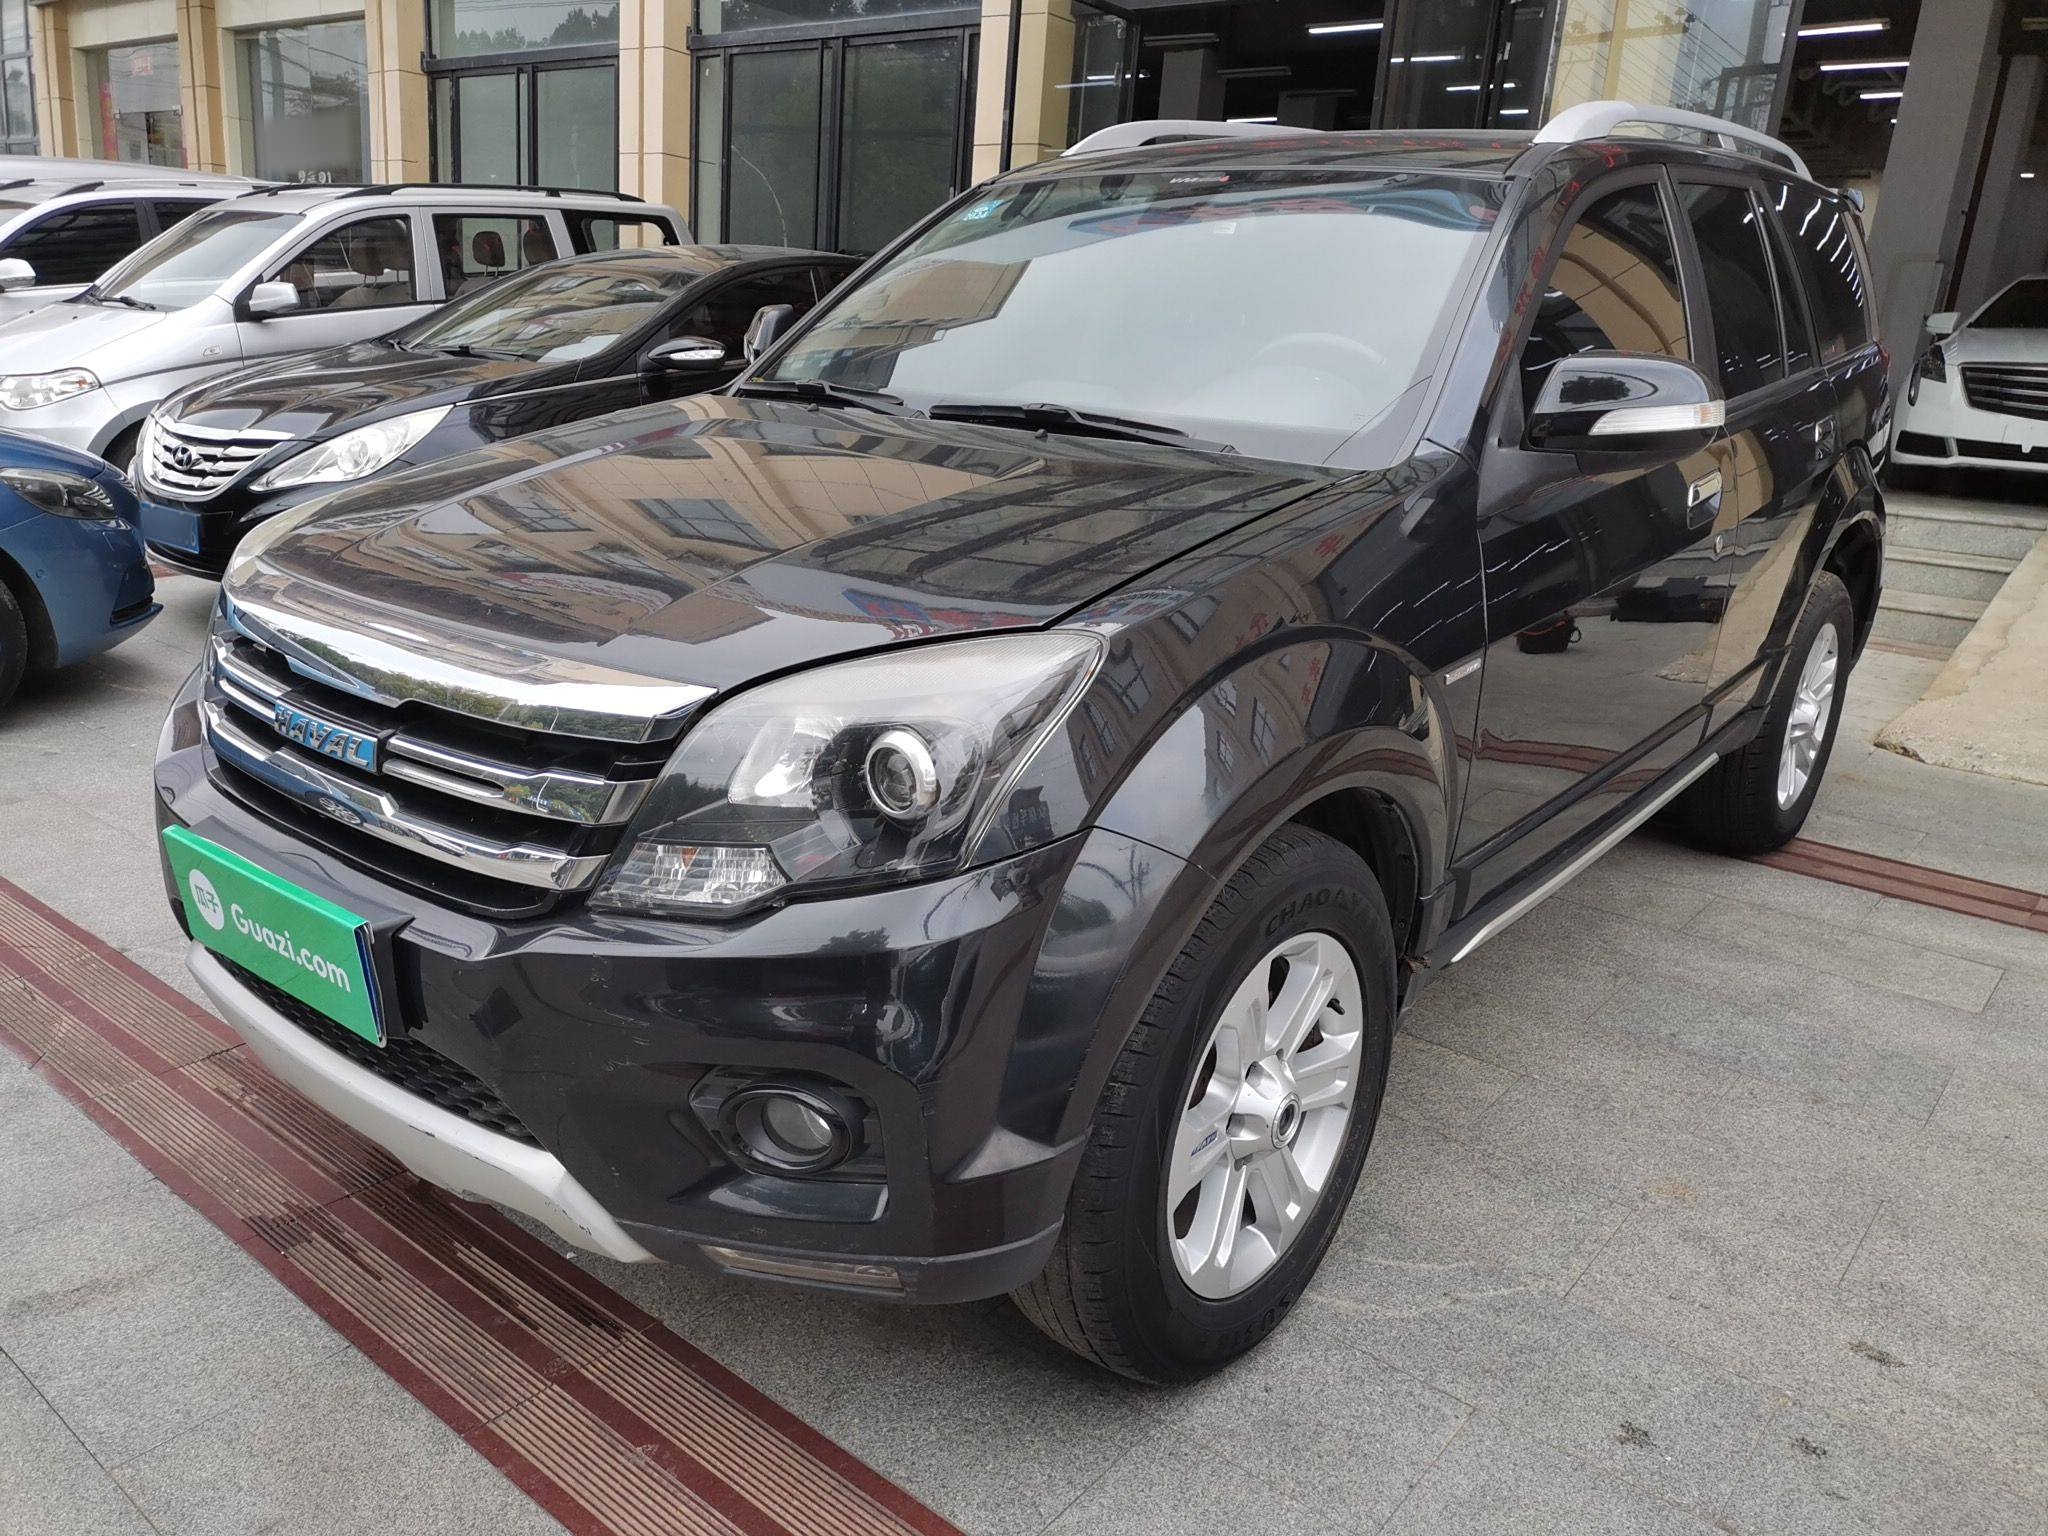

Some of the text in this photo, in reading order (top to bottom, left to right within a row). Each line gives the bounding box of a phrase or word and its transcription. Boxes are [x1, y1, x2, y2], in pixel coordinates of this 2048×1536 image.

[274, 705, 369, 766] HAVAL
[194, 884, 219, 914] 瓜子
[230, 903, 351, 992] Guazi.com
